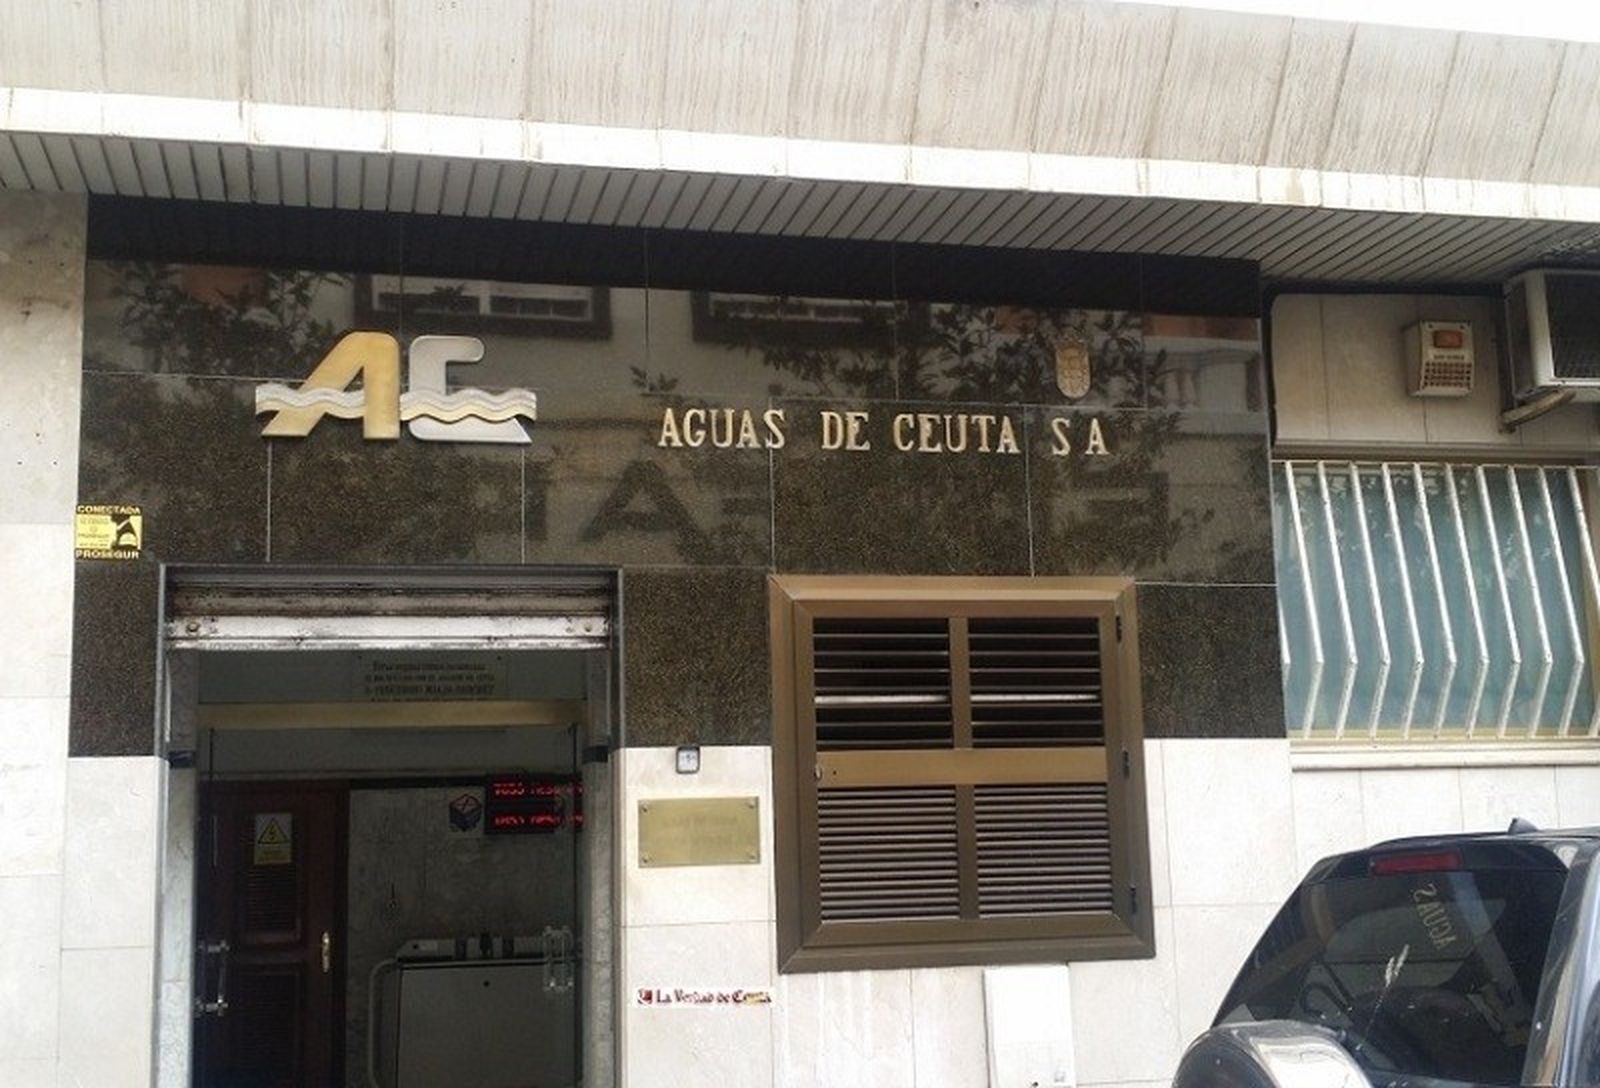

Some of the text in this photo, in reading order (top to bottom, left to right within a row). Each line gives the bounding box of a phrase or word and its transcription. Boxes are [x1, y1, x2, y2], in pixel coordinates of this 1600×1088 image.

[658, 407, 1110, 456] AGUAS DE CEUTA S A
[75, 550, 139, 560] PROSEGUR
[656, 989, 672, 1004] La
[673, 988, 714, 1005] Verdad
[716, 990, 731, 1004] de
